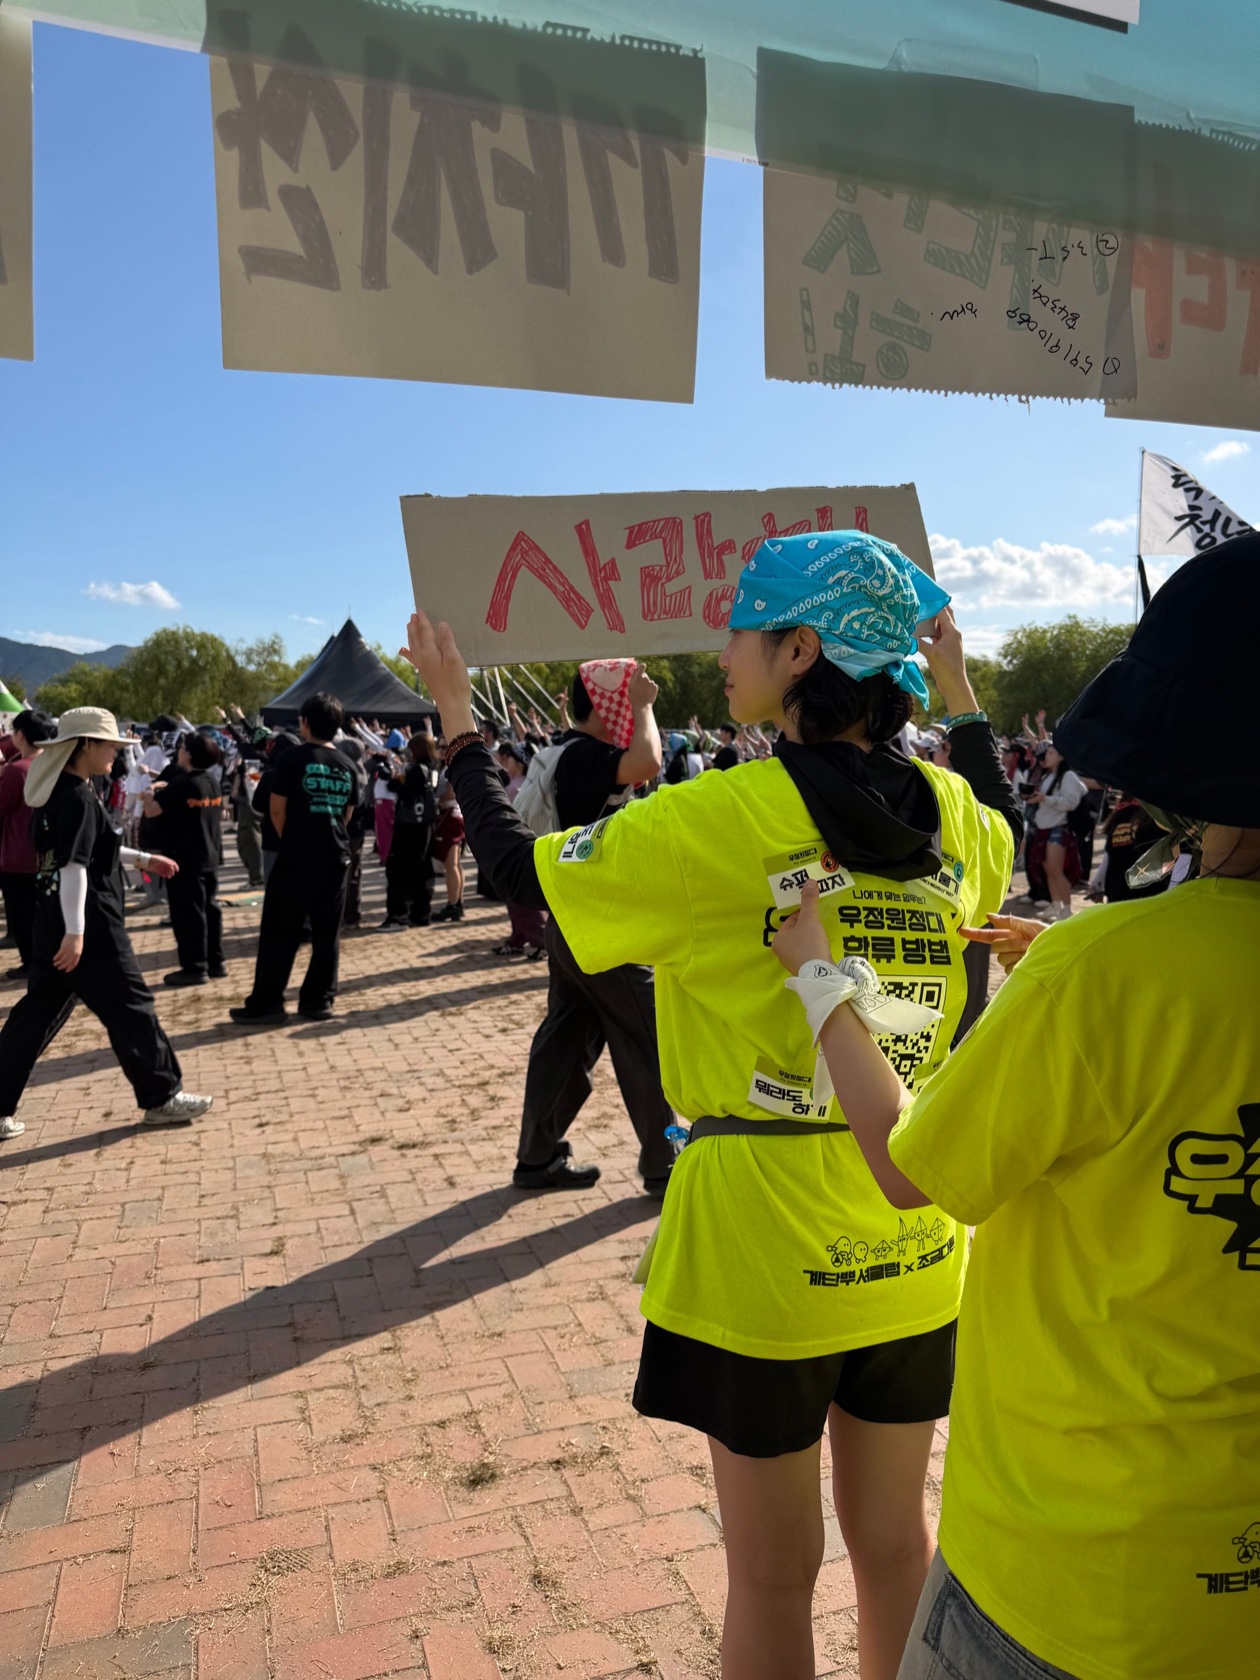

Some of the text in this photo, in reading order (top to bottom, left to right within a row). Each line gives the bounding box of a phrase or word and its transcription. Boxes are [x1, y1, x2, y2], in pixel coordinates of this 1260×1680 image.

[306, 777, 351, 793] STAFF
[852, 889, 883, 900] 나에게
[884, 892, 902, 902] 맞는
[837, 905, 946, 934] 우정원정대
[901, 937, 952, 966] 방법
[755, 1078, 803, 1102] 뭐라도
